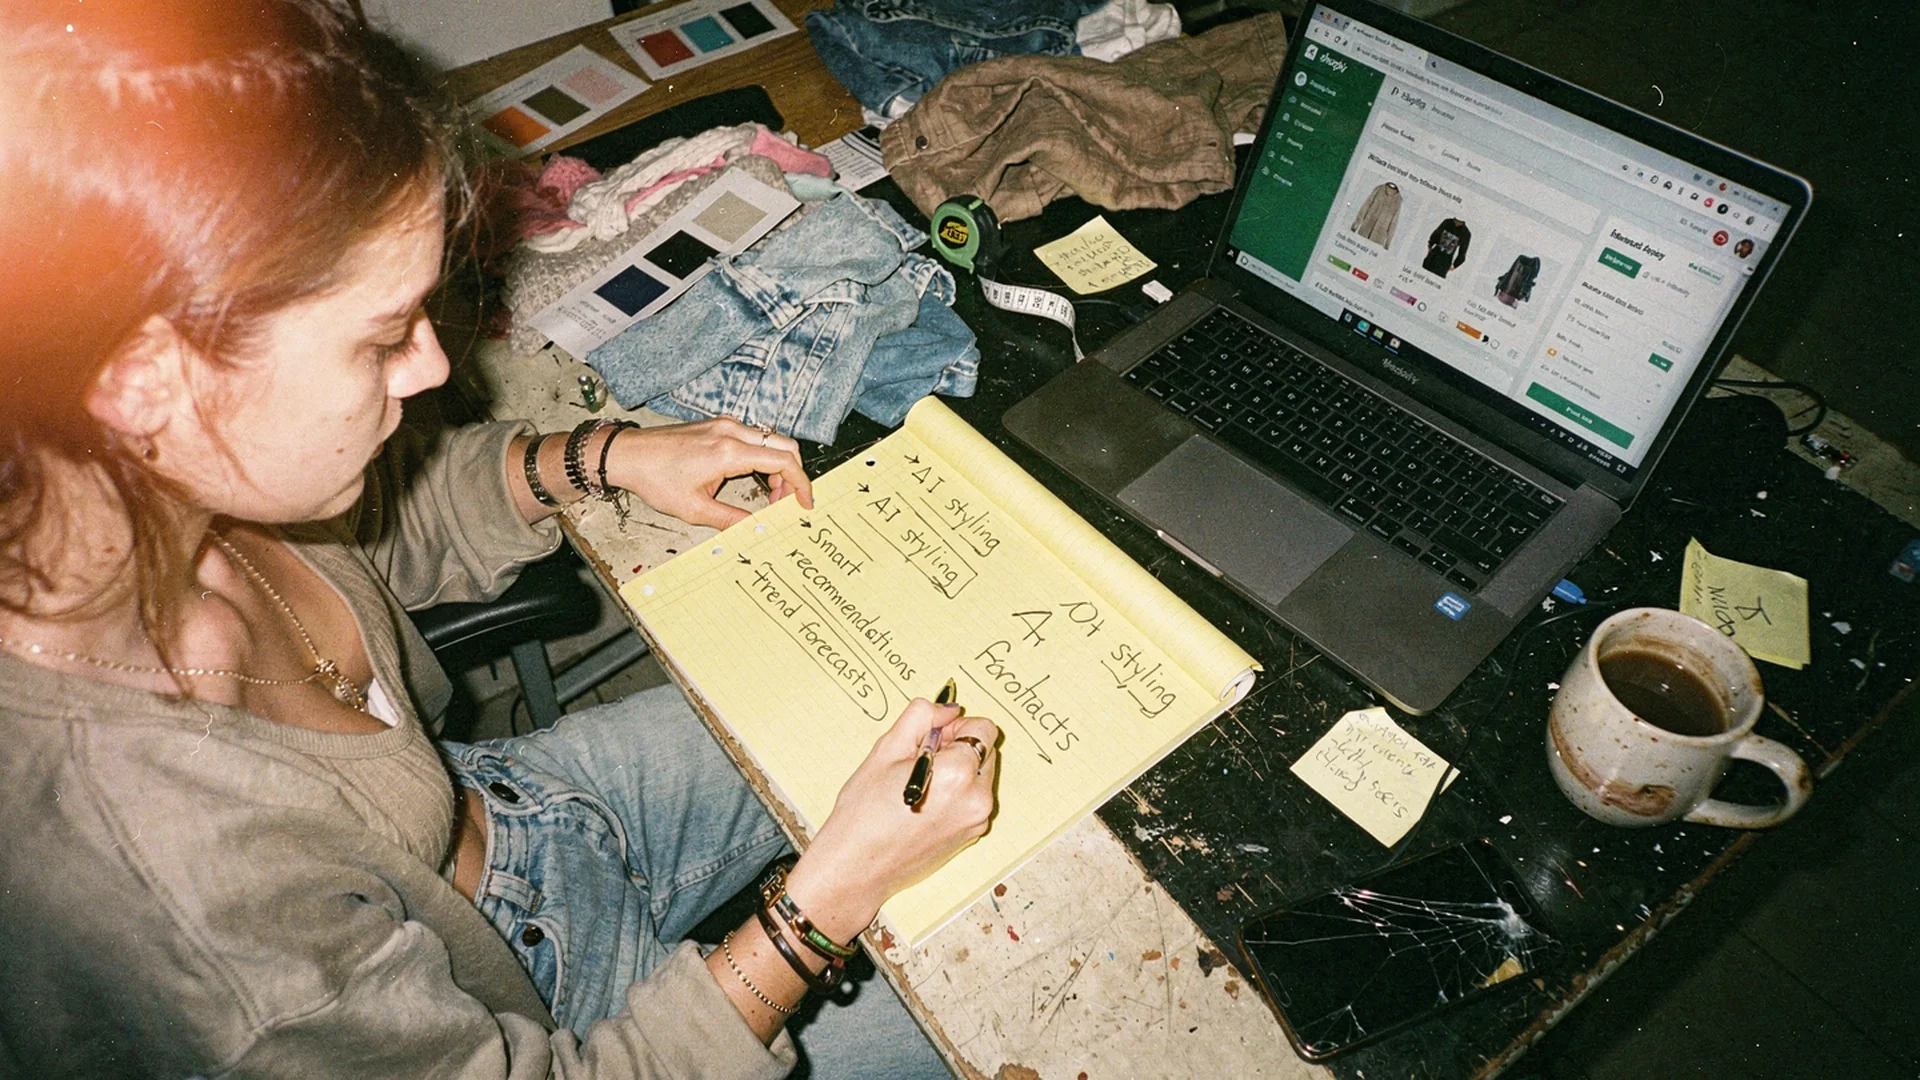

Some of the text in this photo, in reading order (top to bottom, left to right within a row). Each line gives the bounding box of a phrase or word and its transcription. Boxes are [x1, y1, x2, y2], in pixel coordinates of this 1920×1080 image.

[808, 527, 865, 577] Smart
[944, 498, 1001, 557] styling
[900, 529, 959, 588] styling
[752, 569, 874, 699] trend forecasts
[1110, 643, 1177, 716] styling
